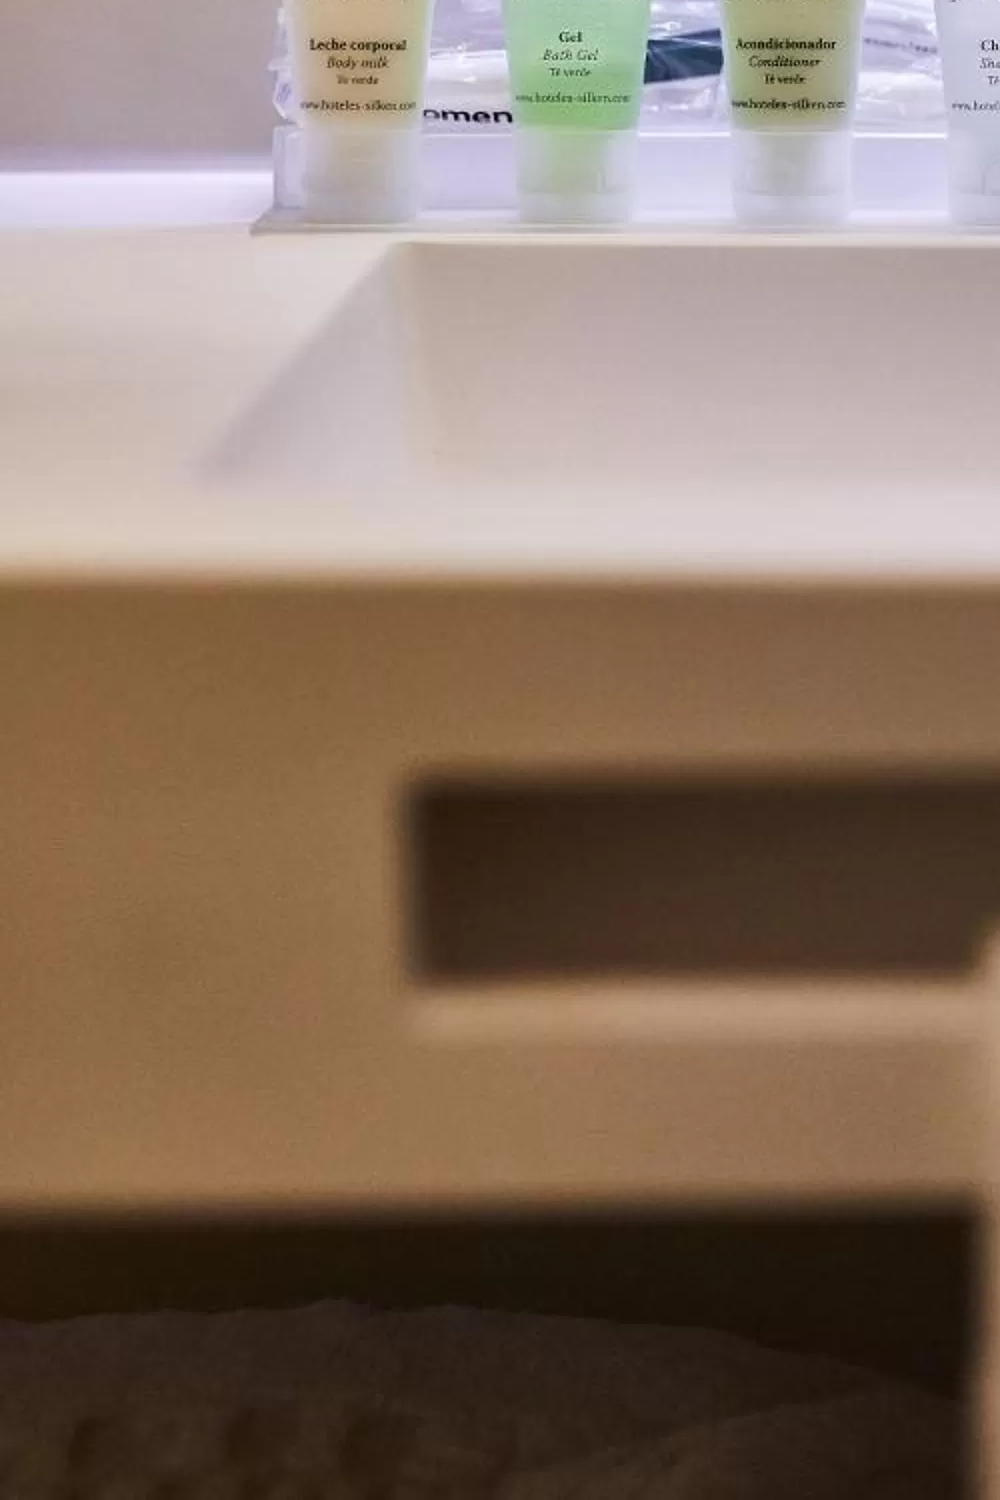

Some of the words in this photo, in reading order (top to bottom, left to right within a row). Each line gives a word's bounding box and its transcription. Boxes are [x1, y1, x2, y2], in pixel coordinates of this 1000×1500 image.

[558, 31, 583, 43] Gel
[309, 38, 347, 51] Leche
[350, 39, 407, 53] corporal
[736, 38, 837, 50] Acondicionador
[543, 49, 573, 61] Bath
[576, 49, 599, 61] Gel
[749, 56, 822, 68] Conditioner
